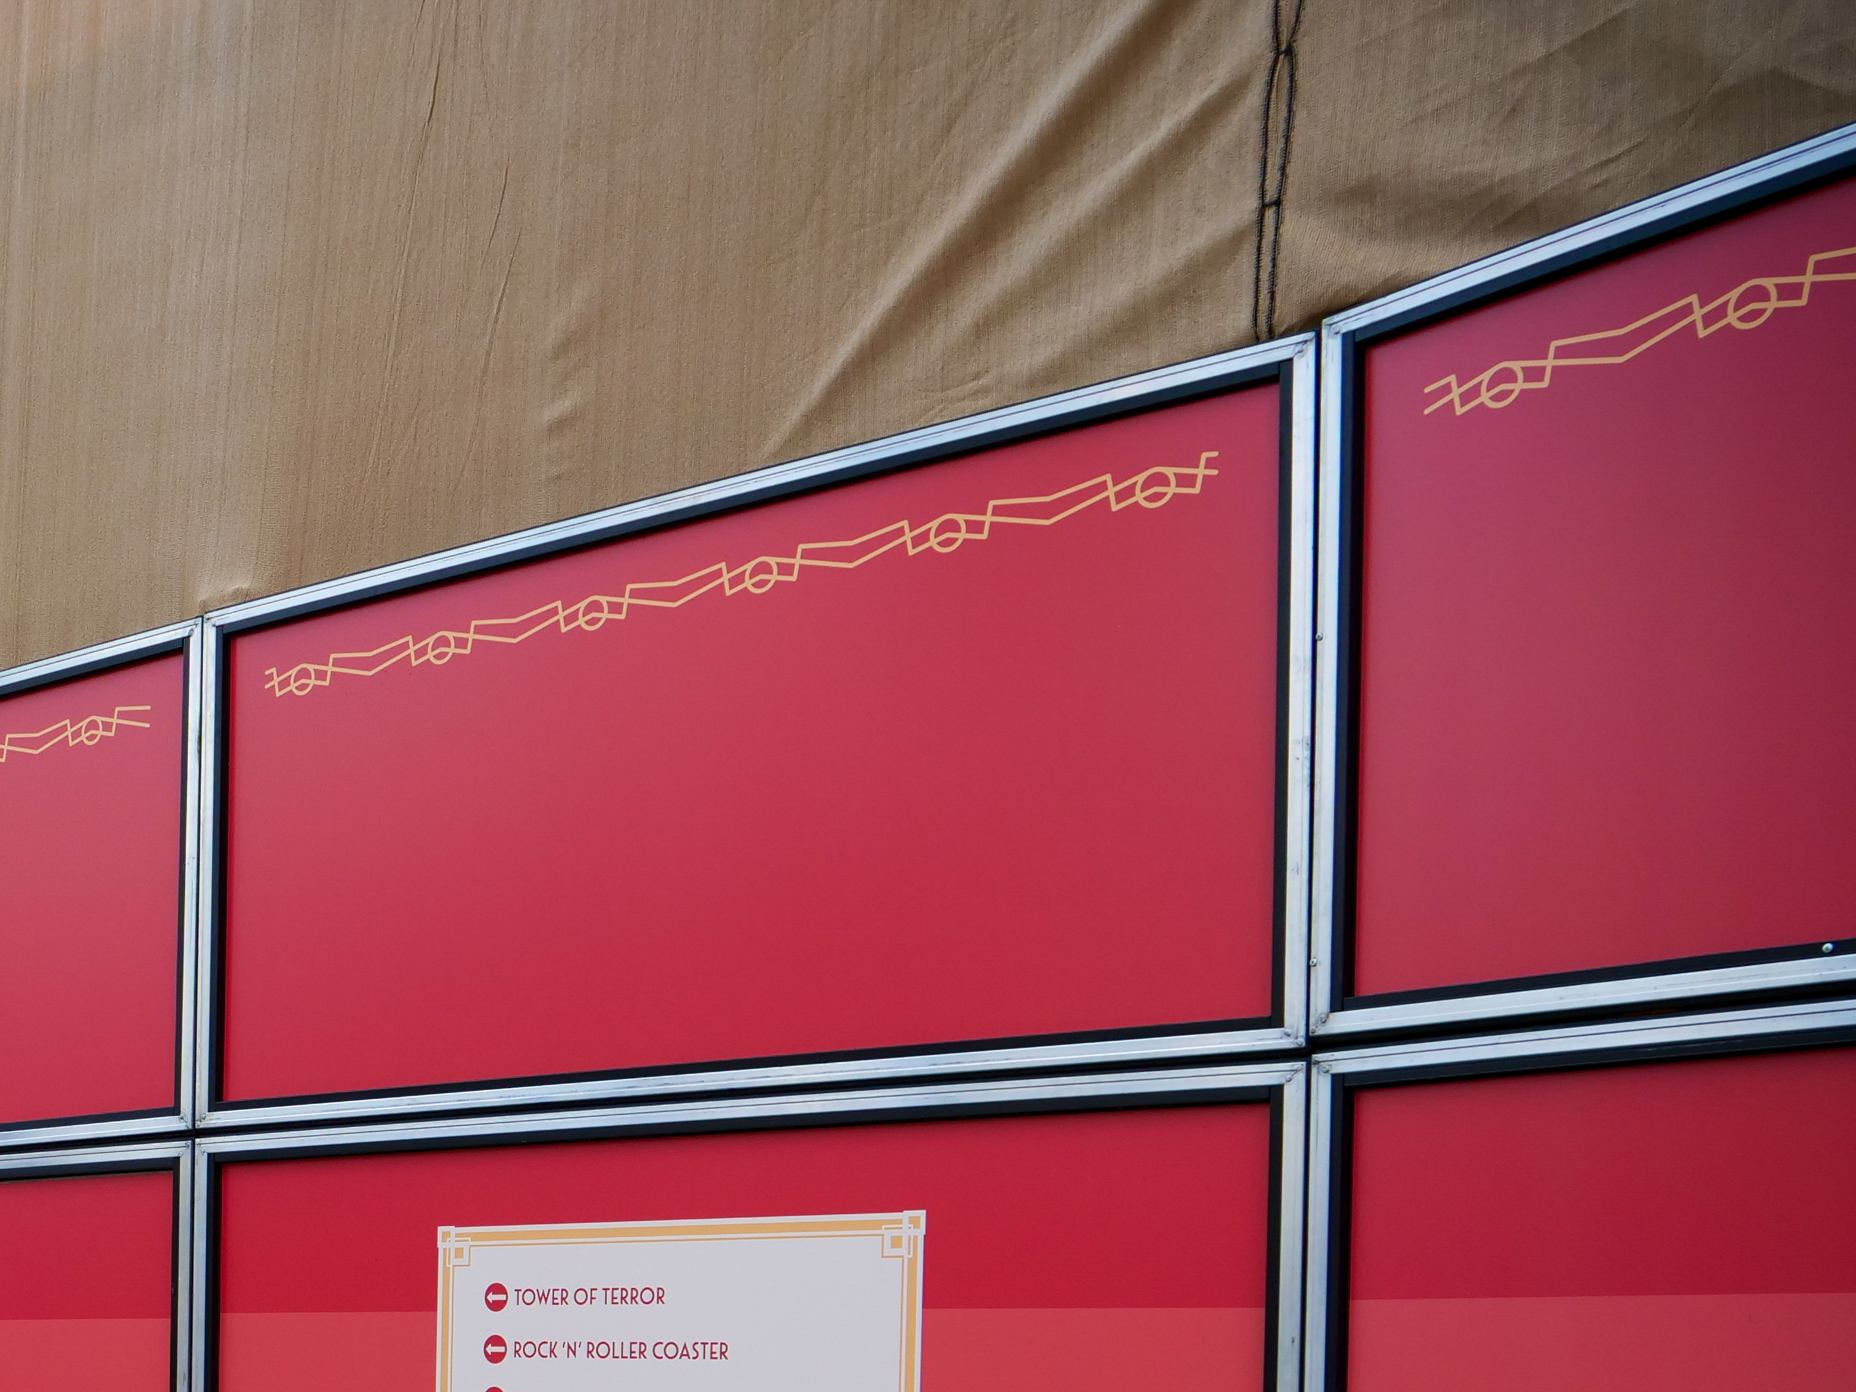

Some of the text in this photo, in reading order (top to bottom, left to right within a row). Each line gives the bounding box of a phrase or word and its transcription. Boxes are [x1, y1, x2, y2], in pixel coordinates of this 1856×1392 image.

[514, 1287, 666, 1306] TOWER OF TERROR
[513, 1341, 558, 1359] ROCK
[586, 1341, 647, 1360] ROLLER
[652, 1341, 729, 1360] COASTER
